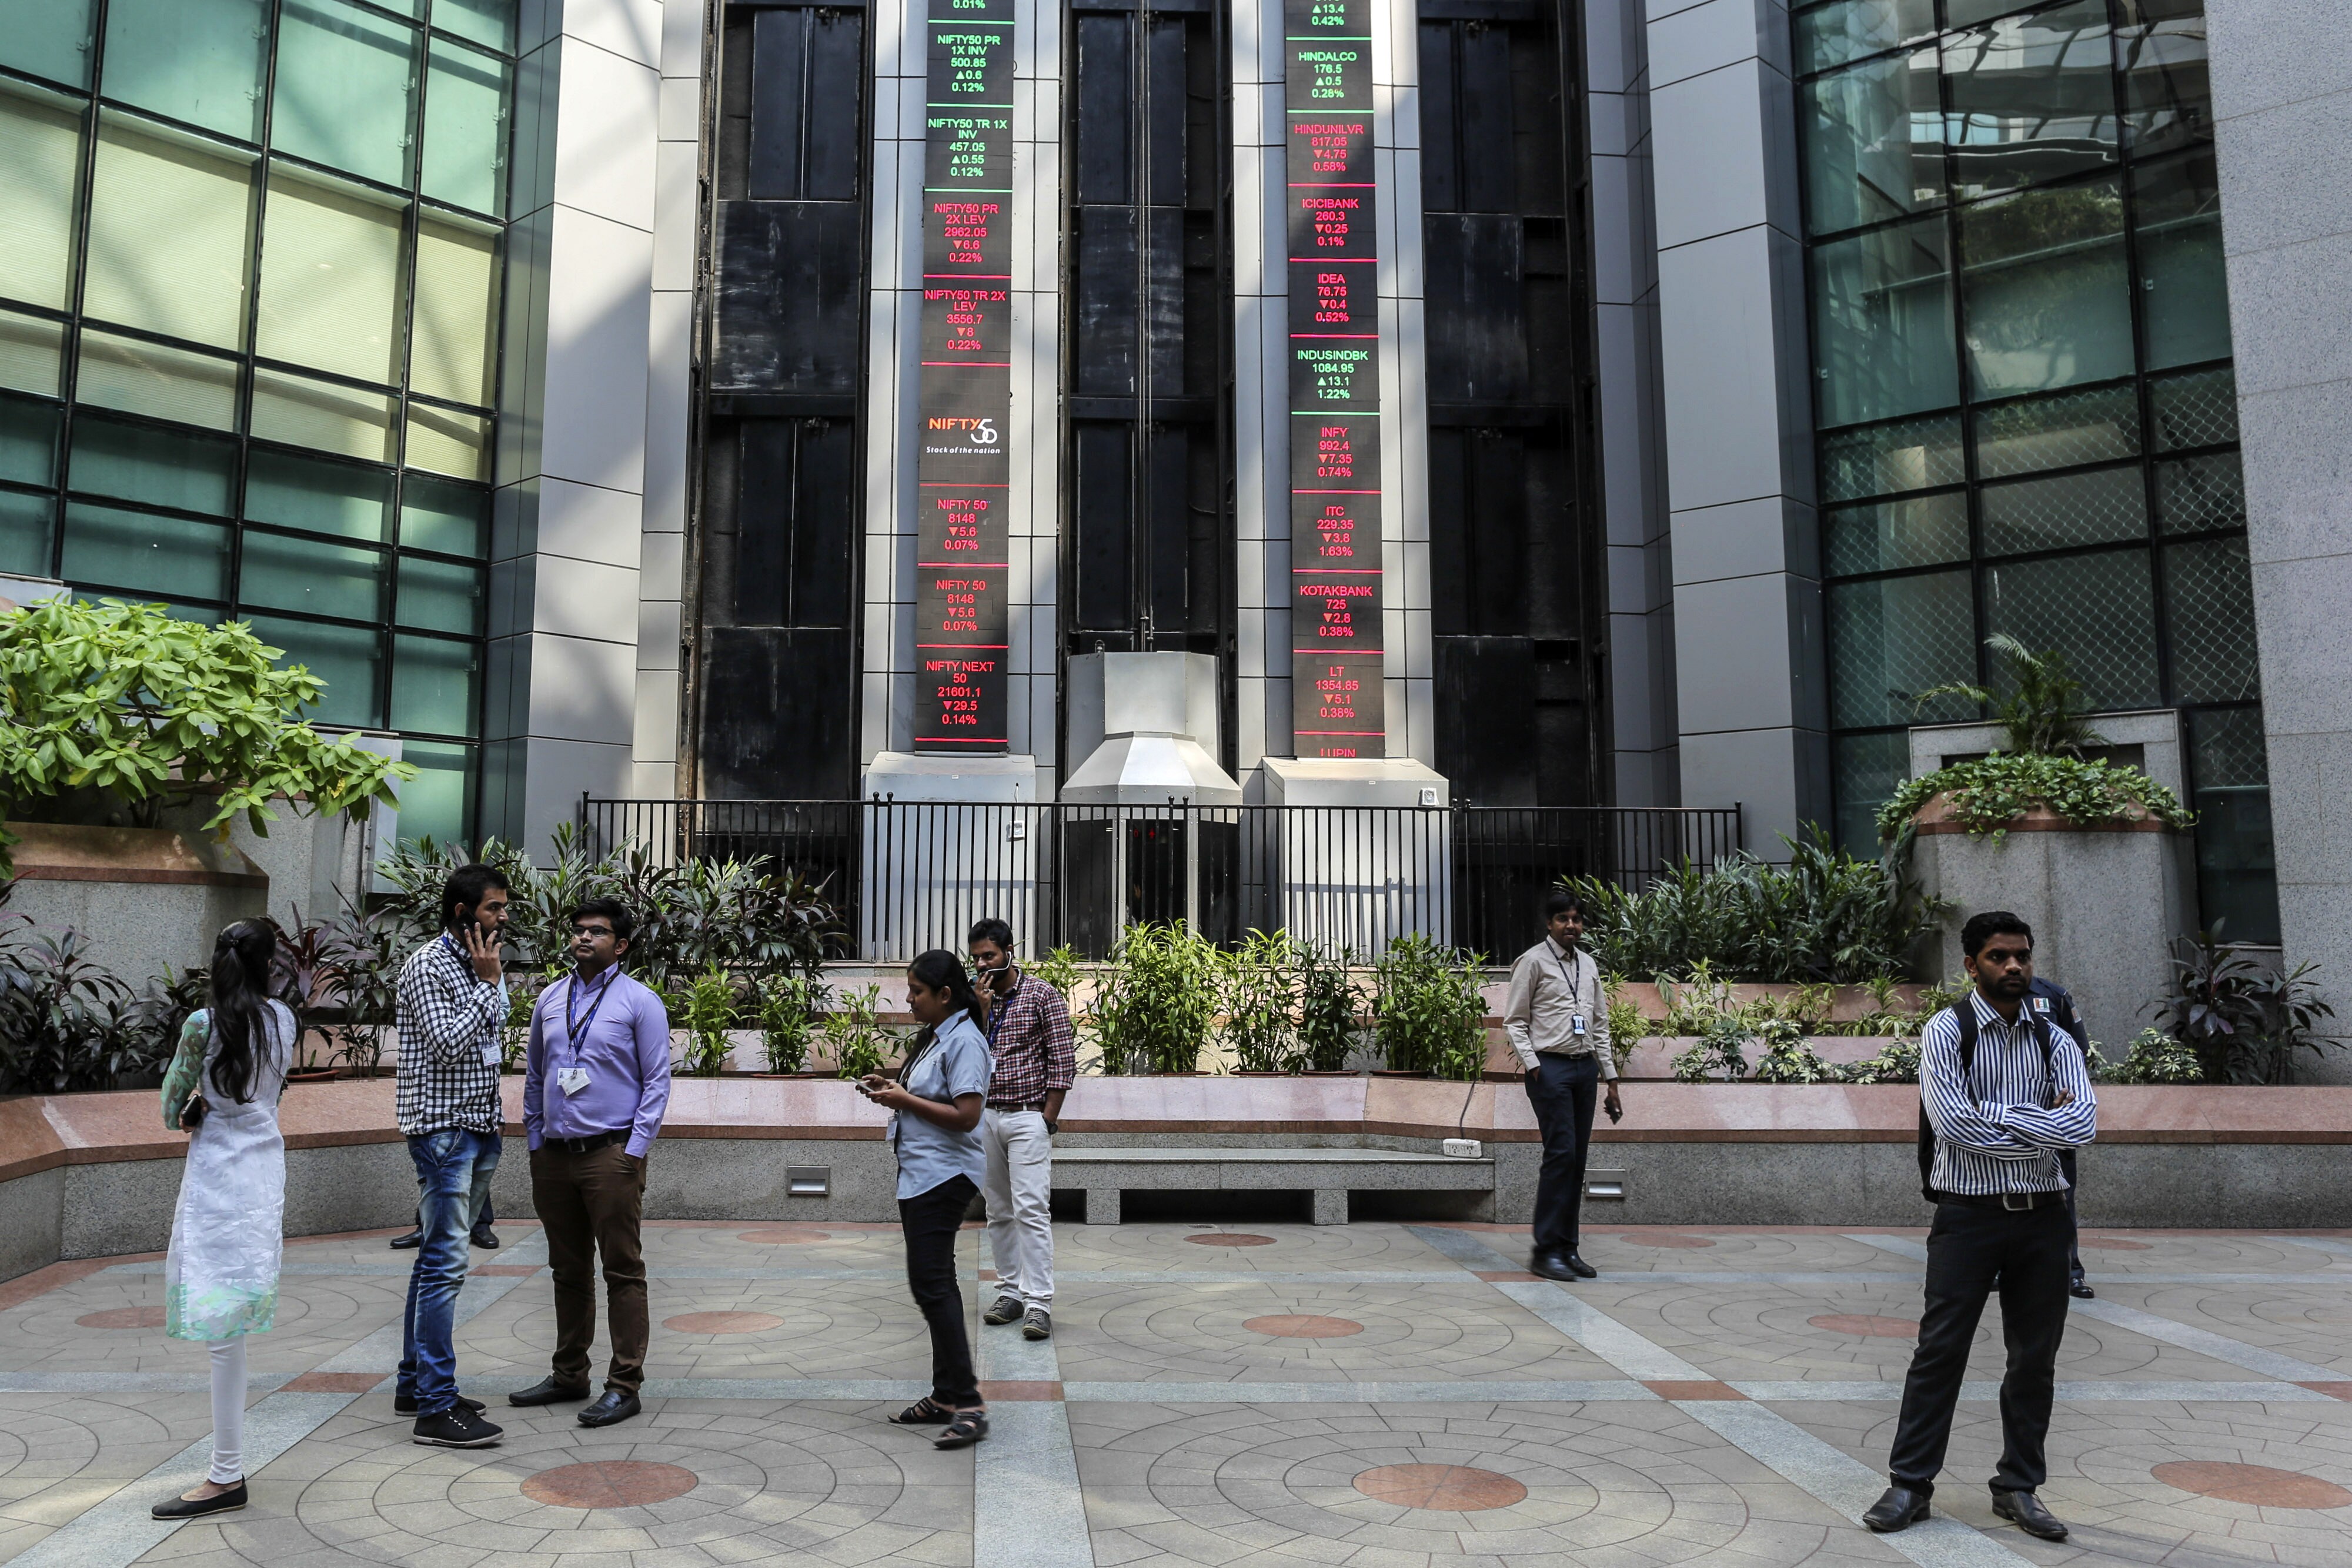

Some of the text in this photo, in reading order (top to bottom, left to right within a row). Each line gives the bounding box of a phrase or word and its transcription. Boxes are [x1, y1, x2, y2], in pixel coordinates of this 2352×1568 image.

[953, 0, 985, 8] 0.01%
[1323, 4, 1345, 13] 13.4
[1311, 15, 1345, 25] 0.42%
[937, 34, 1001, 45] NIFTY50 PR
[952, 45, 987, 55] 1X INV
[1298, 52, 1358, 61] HINDALCO
[951, 58, 987, 67] 500.85
[1315, 63, 1342, 73] 176.5
[964, 70, 983, 79] 0.6
[1324, 76, 1341, 85] 0.5
[951, 82, 985, 92] 0.12%
[1312, 89, 1344, 98] 0.28%
[928, 118, 1007, 129] NIFTY50 TR 1X
[958, 130, 977, 139] INV
[1294, 124, 1364, 135] HINDUNILVR
[950, 142, 986, 151] 457.05
[1311, 136, 1348, 147] 817.05
[960, 155, 984, 163] 0.55
[1323, 149, 1347, 159] 4.75
[950, 167, 983, 176] 0.12%
[1312, 161, 1347, 172] 0.58%
[934, 203, 999, 214] NIFTY50 PR
[1302, 199, 1359, 209] ICICIBANK
[946, 214, 987, 225] 2X LEV
[1129, 208, 1135, 225] 2
[1315, 211, 1346, 221] 260.3
[1324, 223, 1349, 234] 0.25
[1461, 216, 1469, 232] 2
[944, 227, 988, 238] 2962.05
[962, 240, 981, 250] 6.6
[1317, 236, 1345, 246] 0.1%
[949, 252, 983, 263] 0.22%
[1317, 273, 1346, 284] IDEA
[924, 289, 1006, 301] NIFTY50 TR 2X
[1318, 286, 1347, 296] 76.75
[953, 300, 977, 312] LEV
[1328, 299, 1347, 309] 0.4
[947, 314, 984, 325] 3556.7
[1315, 312, 1350, 322] 0.52%
[966, 327, 975, 337] 8
[947, 340, 982, 350] 0.22%
[1298, 350, 1368, 360] INDUSINDBK
[1312, 363, 1354, 373] 1084.95
[1128, 376, 1134, 393] 1
[1329, 376, 1348, 386] 13.1
[1318, 389, 1350, 399] 1.22%
[1321, 427, 1348, 437] INFY
[1319, 440, 1350, 450] 992.4
[1328, 453, 1353, 464] 7.35
[1317, 467, 1353, 477] 0.74%
[937, 499, 988, 510] NIFTY 50
[1325, 506, 1345, 516] ITC
[948, 513, 976, 523] 8148
[1317, 519, 1354, 530] 229.35
[958, 526, 977, 537] 5.6
[1332, 533, 1351, 543] 3.8
[944, 540, 979, 550] 0.07%
[1319, 546, 1354, 556] 1.63%
[936, 580, 986, 590] NIFTY 50
[1299, 585, 1372, 596] KOTAKBANK
[947, 594, 974, 603] 8148
[1326, 599, 1347, 610] 725
[957, 607, 975, 617] 5.6
[1332, 613, 1351, 623] 2.8
[943, 621, 978, 630] 0.07%
[1319, 626, 1355, 637] 0.38%
[926, 661, 995, 671] NIFTY NEXT
[1329, 666, 1344, 677] LT
[953, 673, 967, 683] 50
[1316, 680, 1359, 690] 1354.85
[937, 687, 981, 697] 21601.1
[1334, 694, 1351, 704] 5.1
[953, 700, 978, 711] 29.5
[1319, 707, 1355, 718] 0.38%
[942, 714, 977, 724] 0.14%
